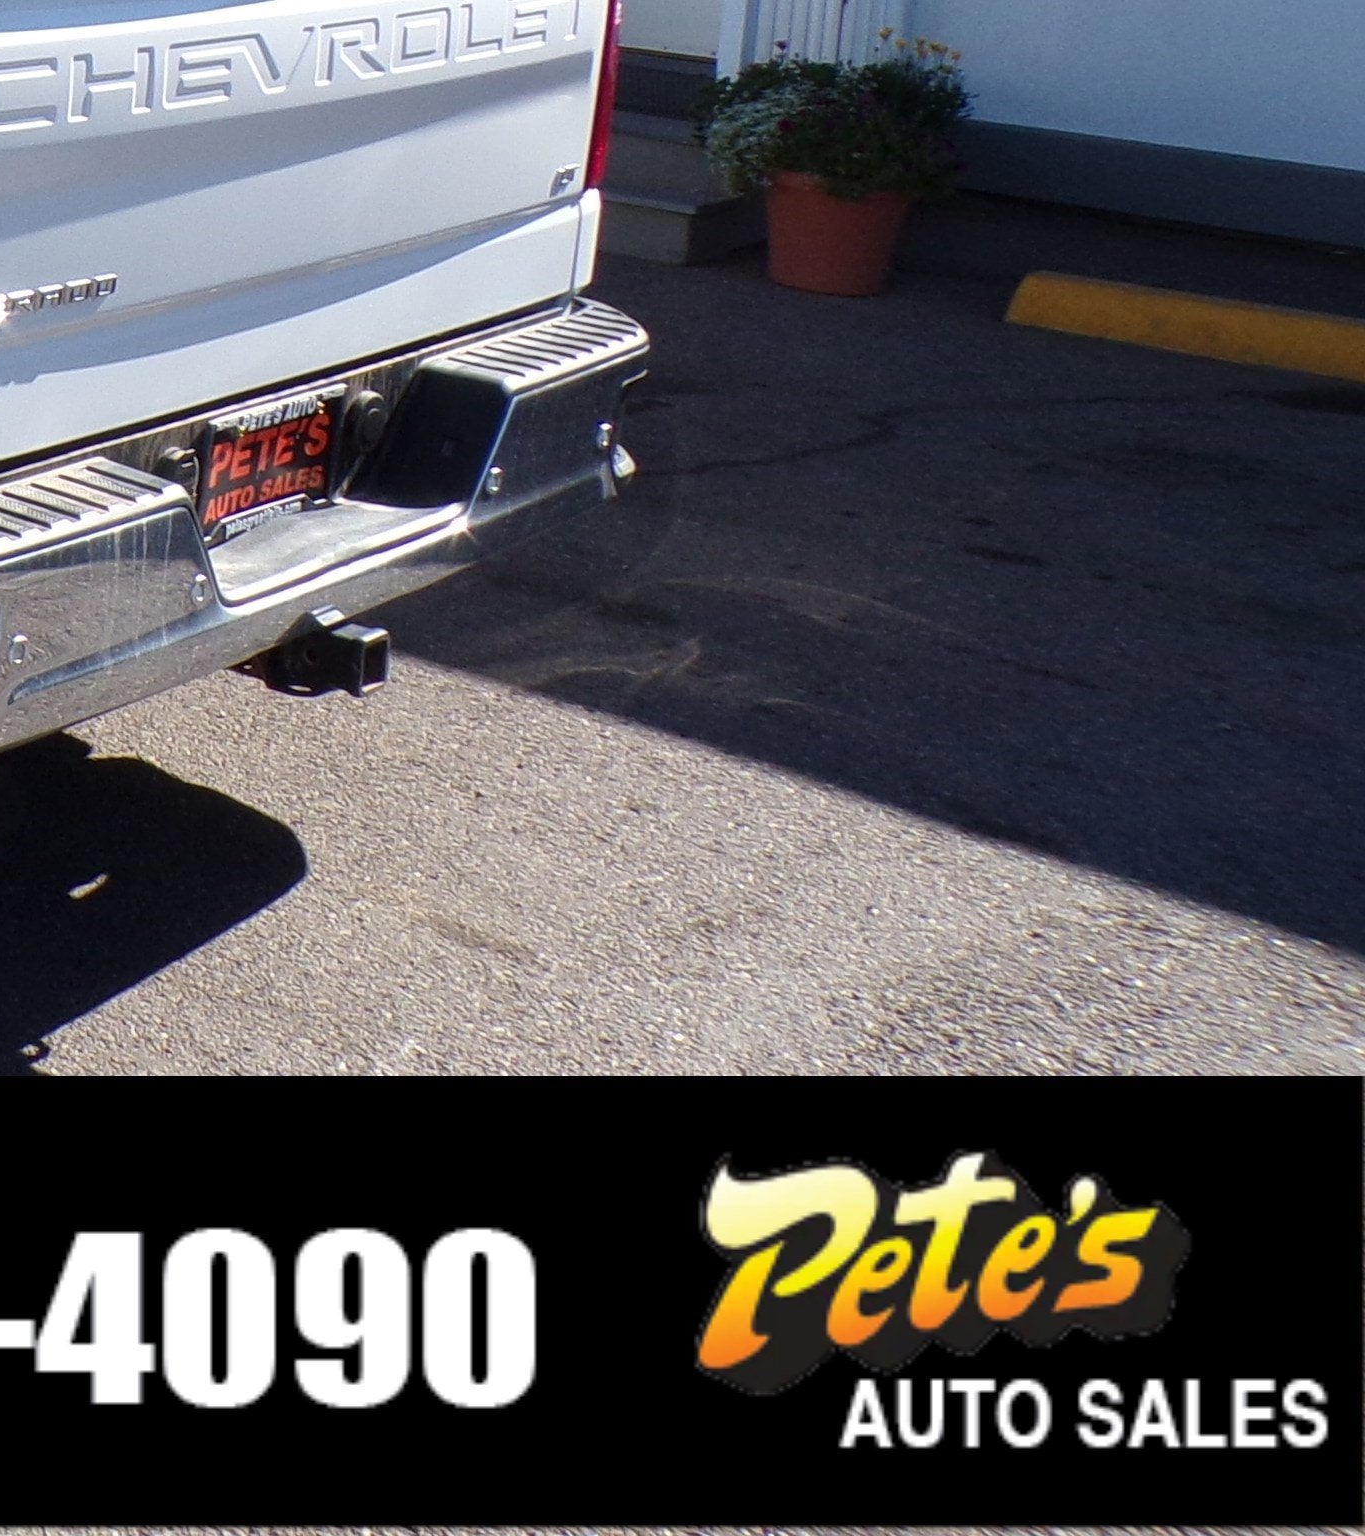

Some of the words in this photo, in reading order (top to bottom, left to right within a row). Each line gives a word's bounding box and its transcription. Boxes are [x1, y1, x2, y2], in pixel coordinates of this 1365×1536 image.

[208, 413, 330, 489] PETE'S
[203, 484, 256, 525] AUTO
[259, 465, 324, 502] SALES
